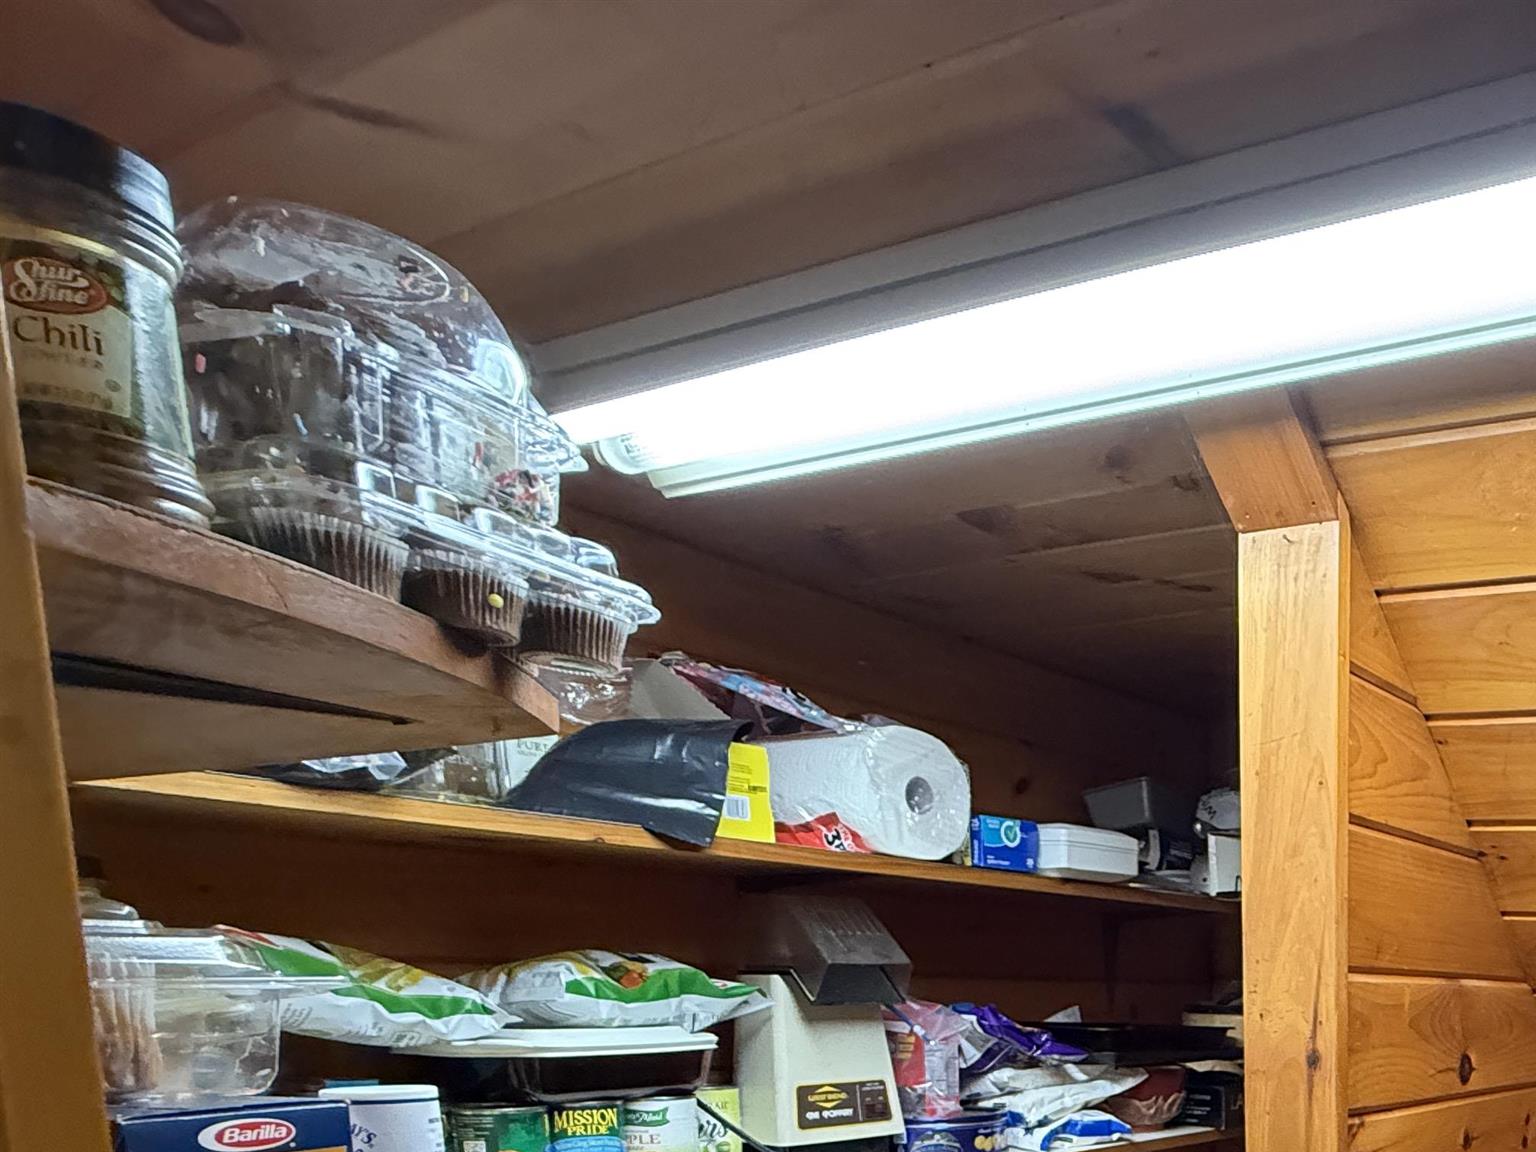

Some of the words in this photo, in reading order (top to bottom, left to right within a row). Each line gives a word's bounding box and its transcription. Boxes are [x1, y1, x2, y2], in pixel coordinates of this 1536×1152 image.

[13, 316, 104, 356] Chili
[554, 1108, 618, 1133] MISSION
[567, 1125, 610, 1136] PRIDE
[222, 1125, 288, 1144] Barilla
